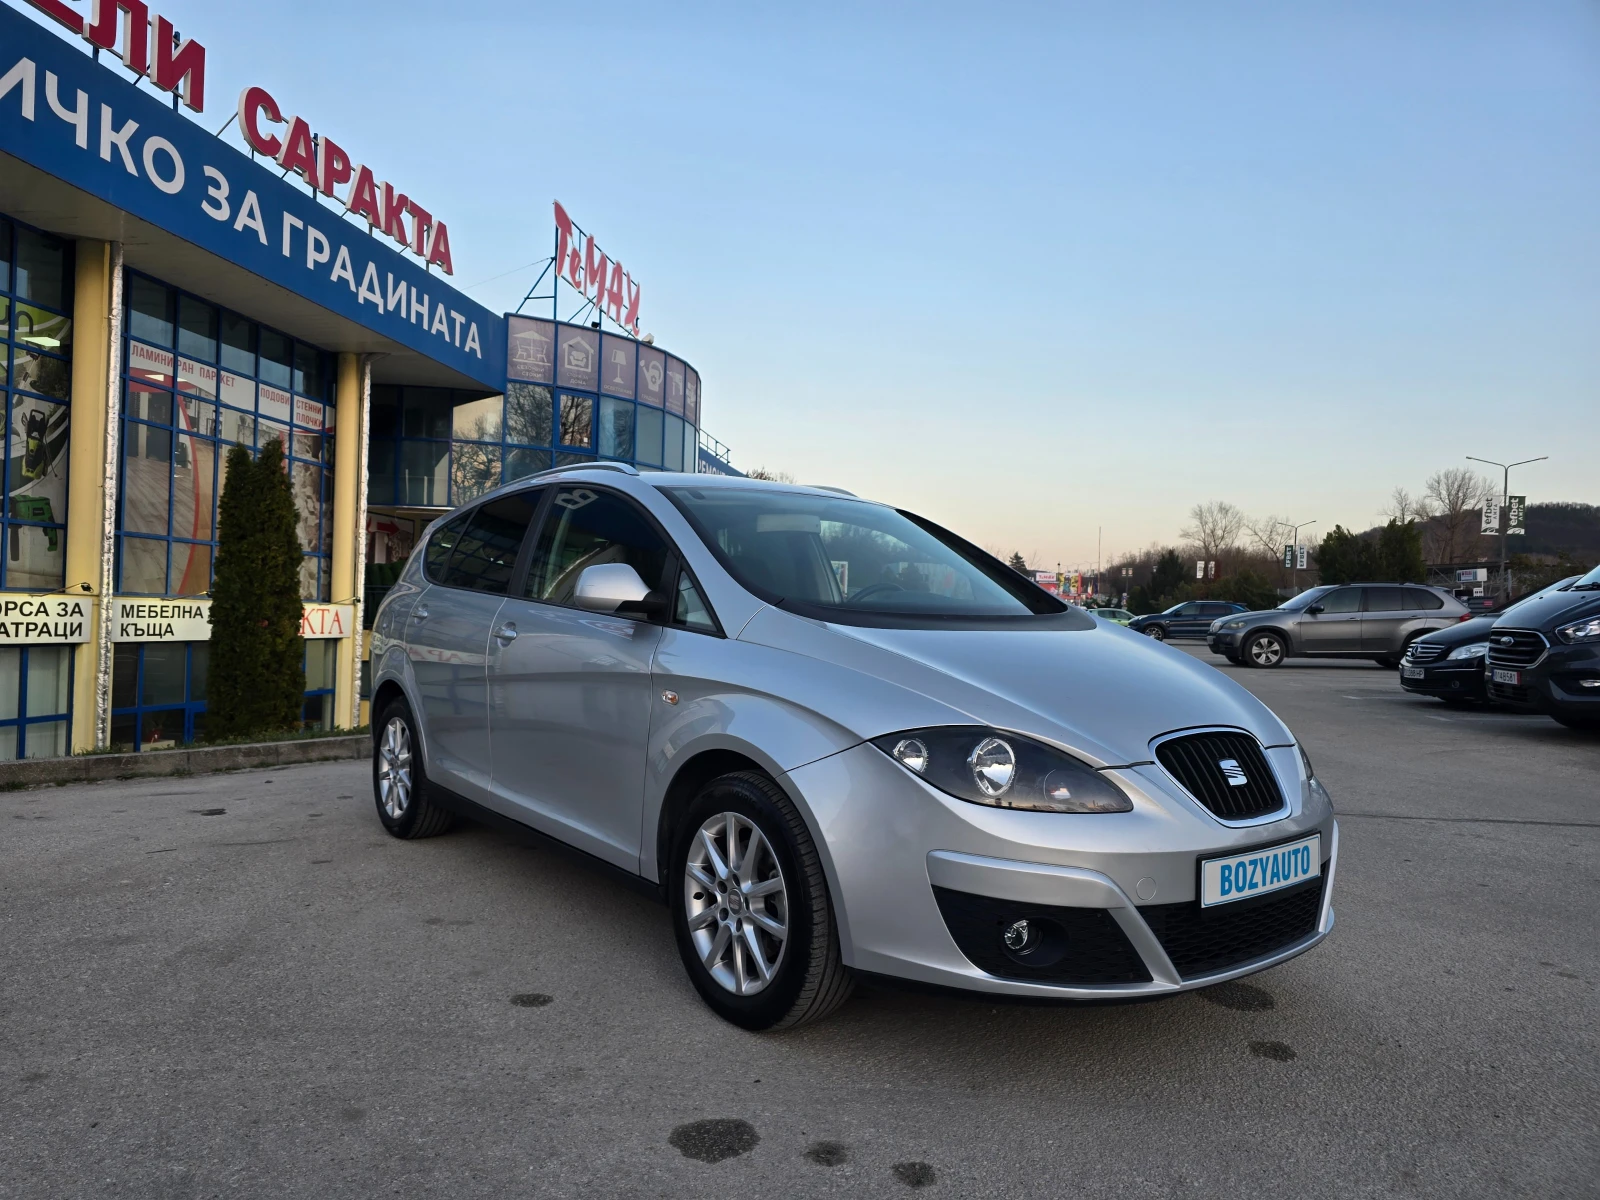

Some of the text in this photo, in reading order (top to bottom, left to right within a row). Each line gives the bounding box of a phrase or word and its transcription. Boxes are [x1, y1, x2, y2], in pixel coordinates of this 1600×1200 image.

[238, 86, 454, 277] САРАКТА
[201, 165, 269, 247] ЗА
[282, 210, 483, 360] ГРАДИНАТА
[199, 367, 236, 388] ПАРКЕТ
[260, 387, 290, 406] ПОДОВИ
[296, 399, 322, 415] СТЕННИ
[296, 412, 323, 427] ПЛОЧКИ
[1484, 497, 1493, 525] efbet
[1509, 497, 1519, 526] efbet
[0, 601, 84, 618] РСА ЗА
[121, 604, 204, 619] МЕБЕЛНА
[120, 623, 175, 639] КЪЩА
[1220, 845, 1311, 897] BOZYAUTO
